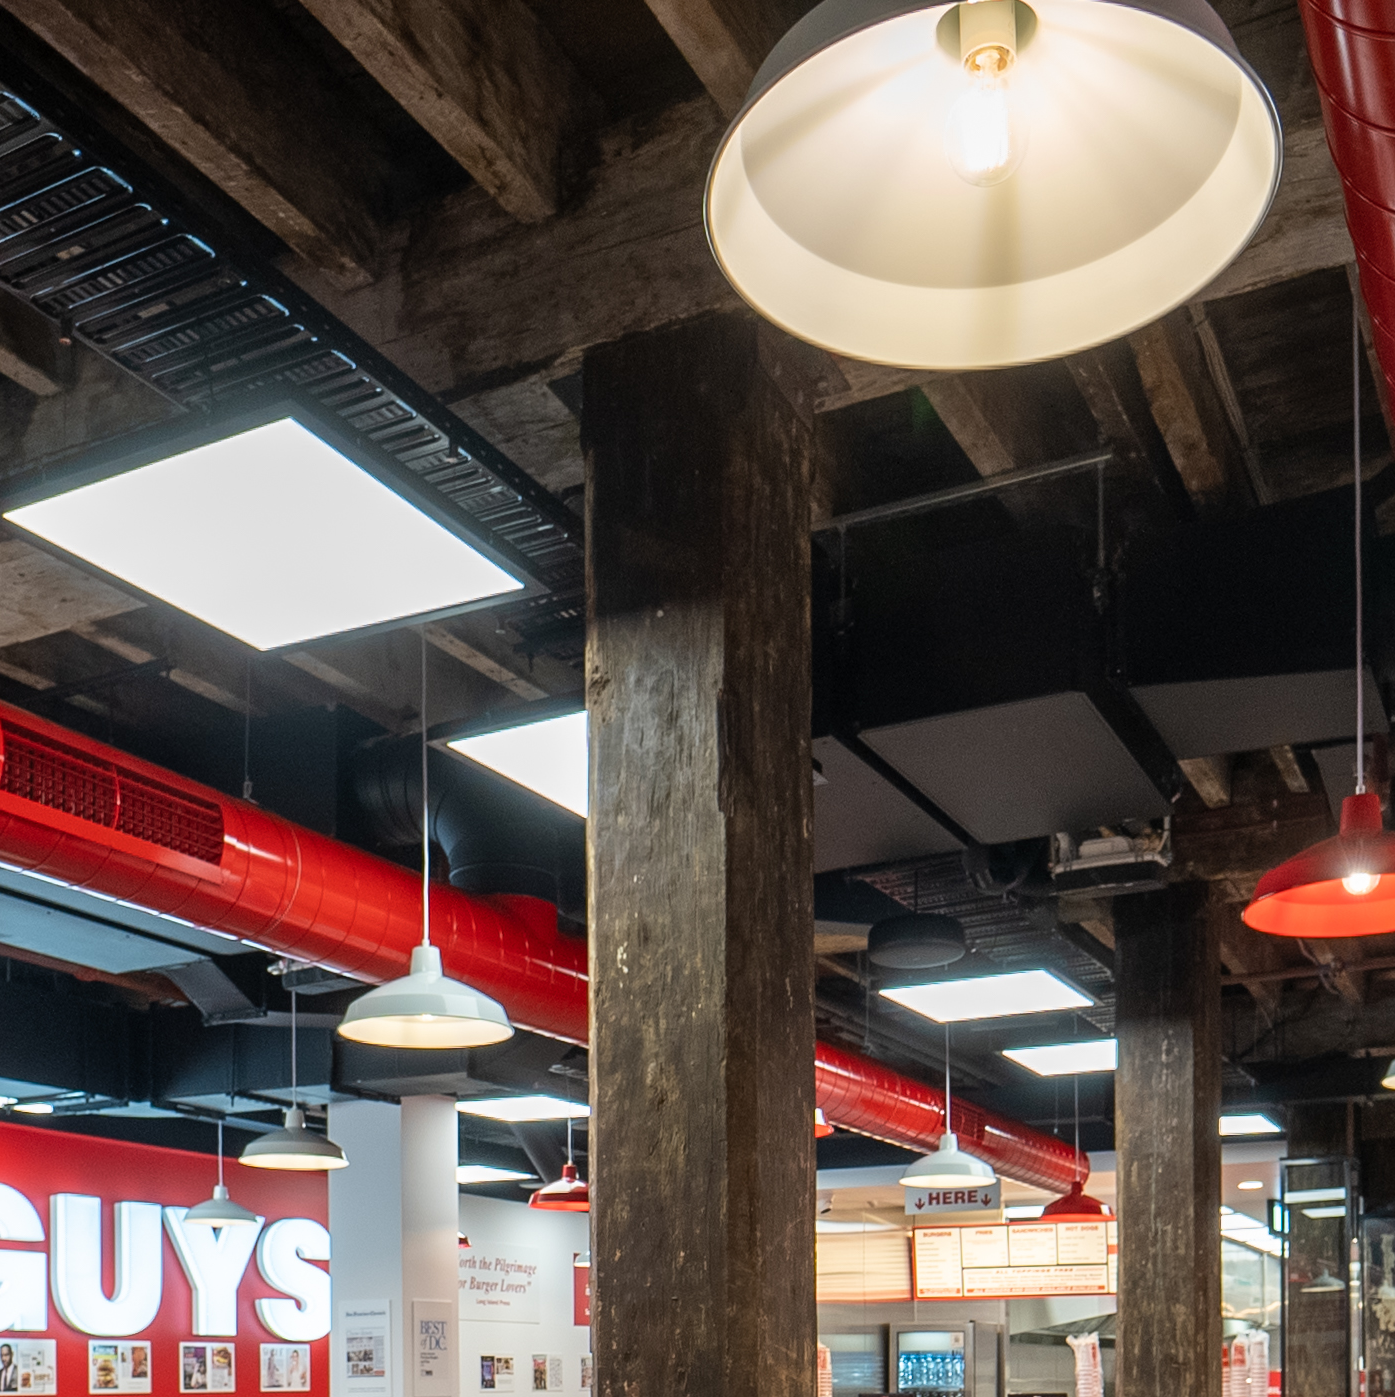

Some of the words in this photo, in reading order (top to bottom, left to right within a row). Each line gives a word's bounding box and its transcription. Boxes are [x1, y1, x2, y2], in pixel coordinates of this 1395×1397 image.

[927, 1189, 979, 1206] HERE
[458, 1255, 476, 1270] orth
[479, 1256, 491, 1271] the
[494, 1257, 537, 1277] Pilgrimage
[469, 1276, 498, 1295] Burger
[420, 1320, 447, 1335] BEST
